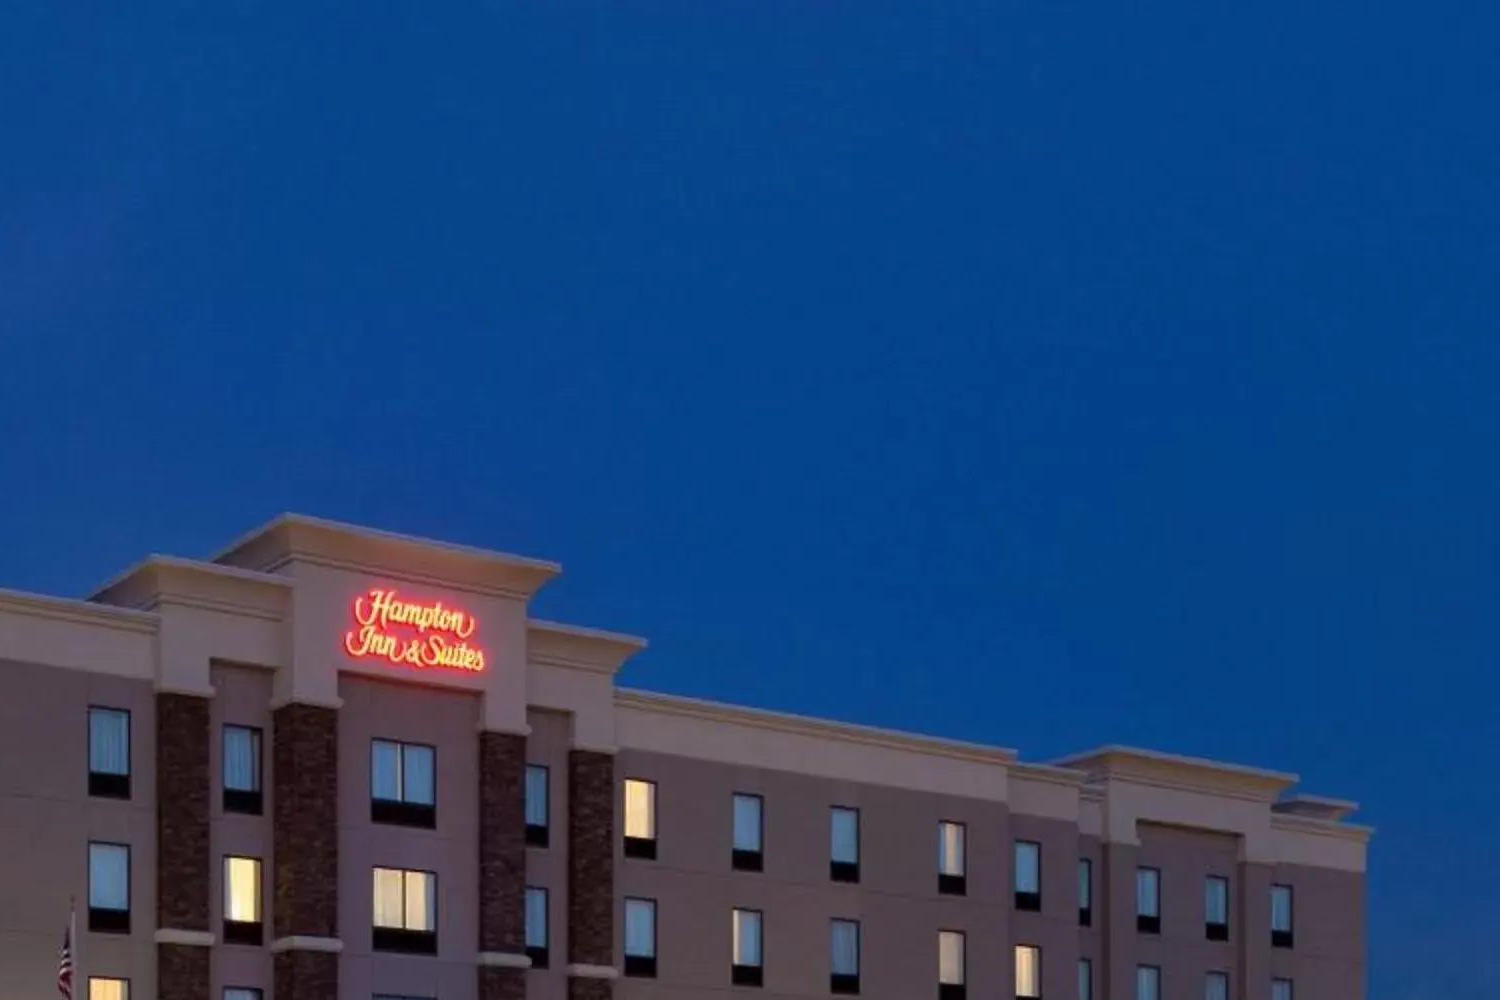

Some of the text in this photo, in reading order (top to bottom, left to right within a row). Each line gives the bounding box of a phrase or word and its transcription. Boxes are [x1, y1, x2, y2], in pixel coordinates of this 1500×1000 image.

[355, 590, 475, 638] Hampton
[345, 625, 484, 671] Inn & Suites
